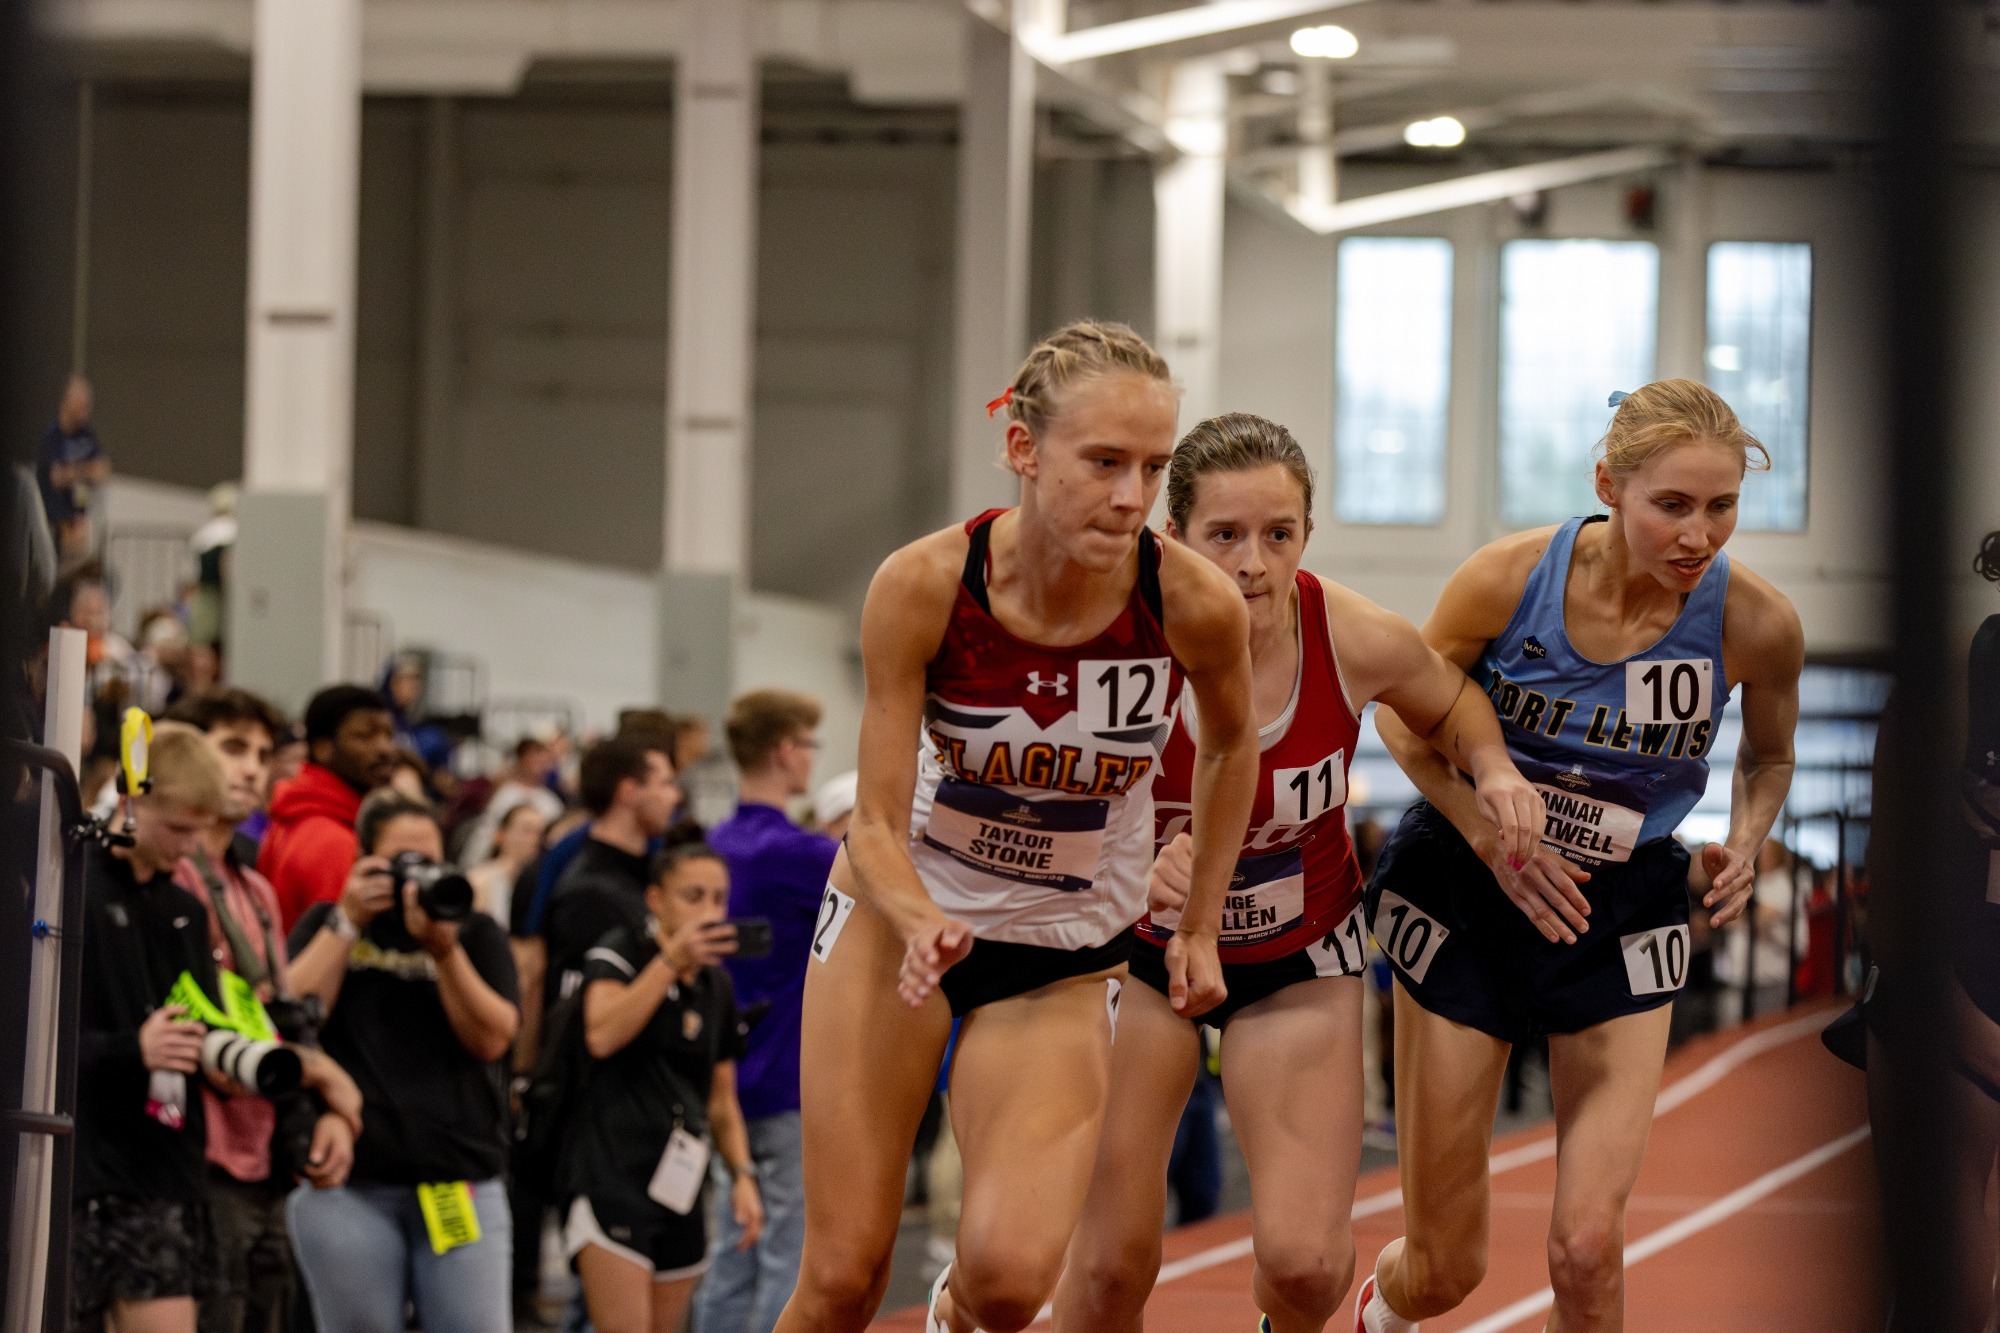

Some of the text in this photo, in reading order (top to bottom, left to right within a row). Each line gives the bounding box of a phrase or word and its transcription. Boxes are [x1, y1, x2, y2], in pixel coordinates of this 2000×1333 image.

[1523, 639, 1545, 657] MAC
[1096, 663, 1157, 729] 12
[1642, 663, 1699, 721] 10
[1582, 704, 1712, 759] LEWIS
[1289, 758, 1333, 821] 11
[1536, 788, 1604, 827] ANNAH
[969, 838, 1054, 870] STONE
[979, 822, 1054, 850] TAYLOR
[1543, 814, 1614, 855] TWELL
[1221, 905, 1277, 931] LLEN
[1223, 894, 1256, 910] IGE
[1321, 913, 1365, 973] 11
[1388, 904, 1432, 971] 10
[1639, 929, 1684, 989] 10
